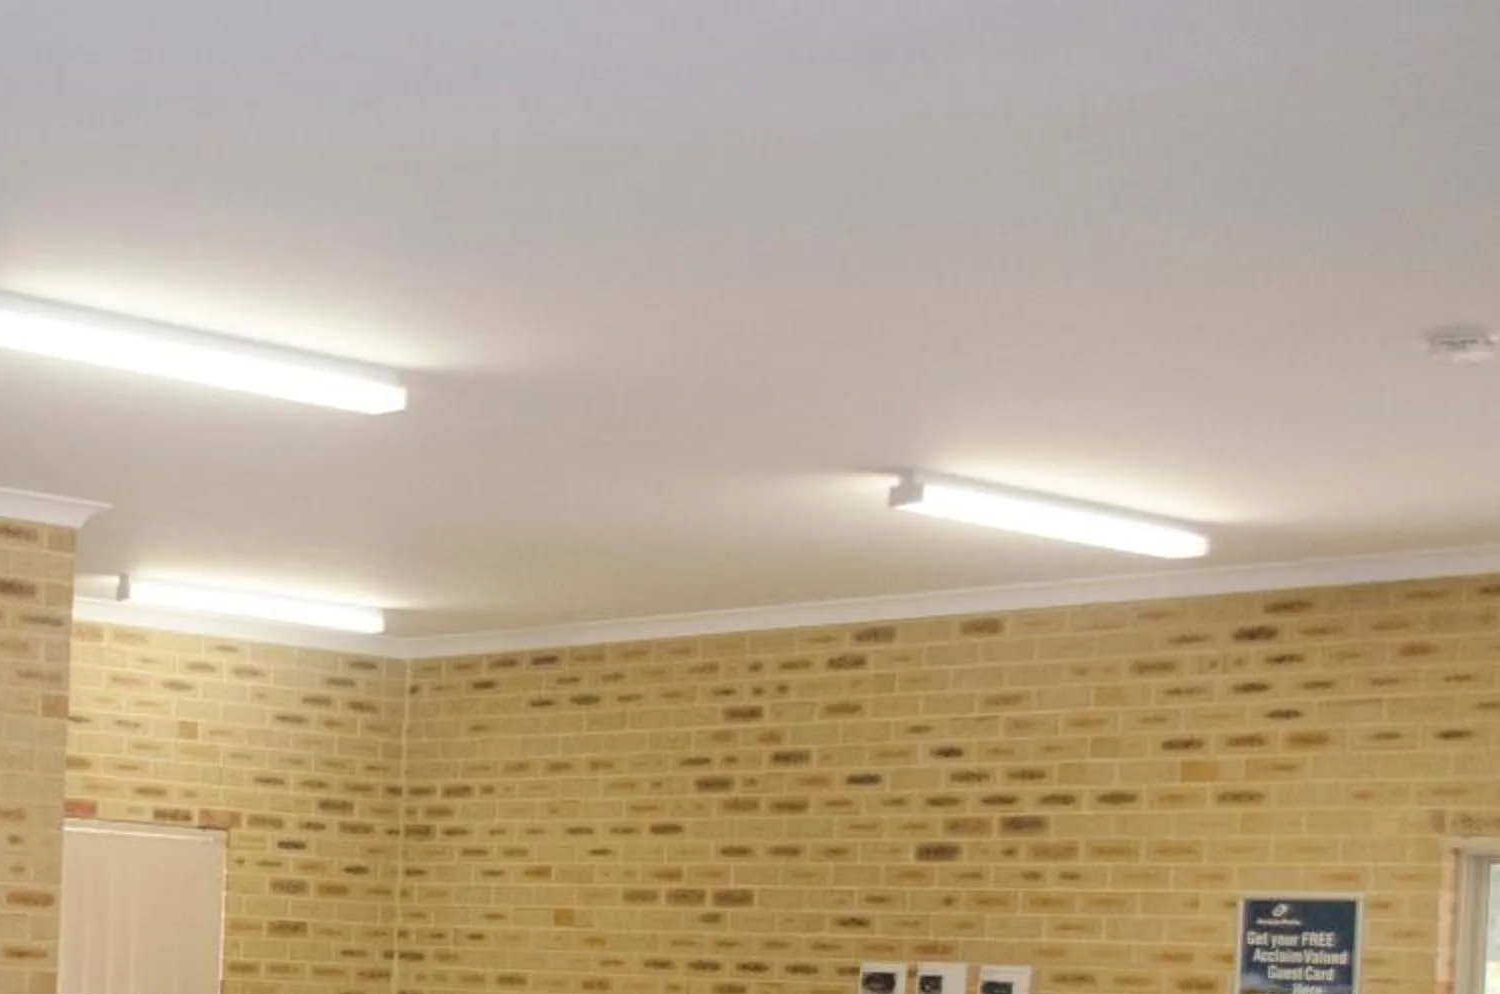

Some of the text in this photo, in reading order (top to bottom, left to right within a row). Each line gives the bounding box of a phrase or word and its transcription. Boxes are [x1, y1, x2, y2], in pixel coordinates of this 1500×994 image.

[1247, 931, 1336, 948] Get your FREE
[1305, 966, 1335, 981] Card
